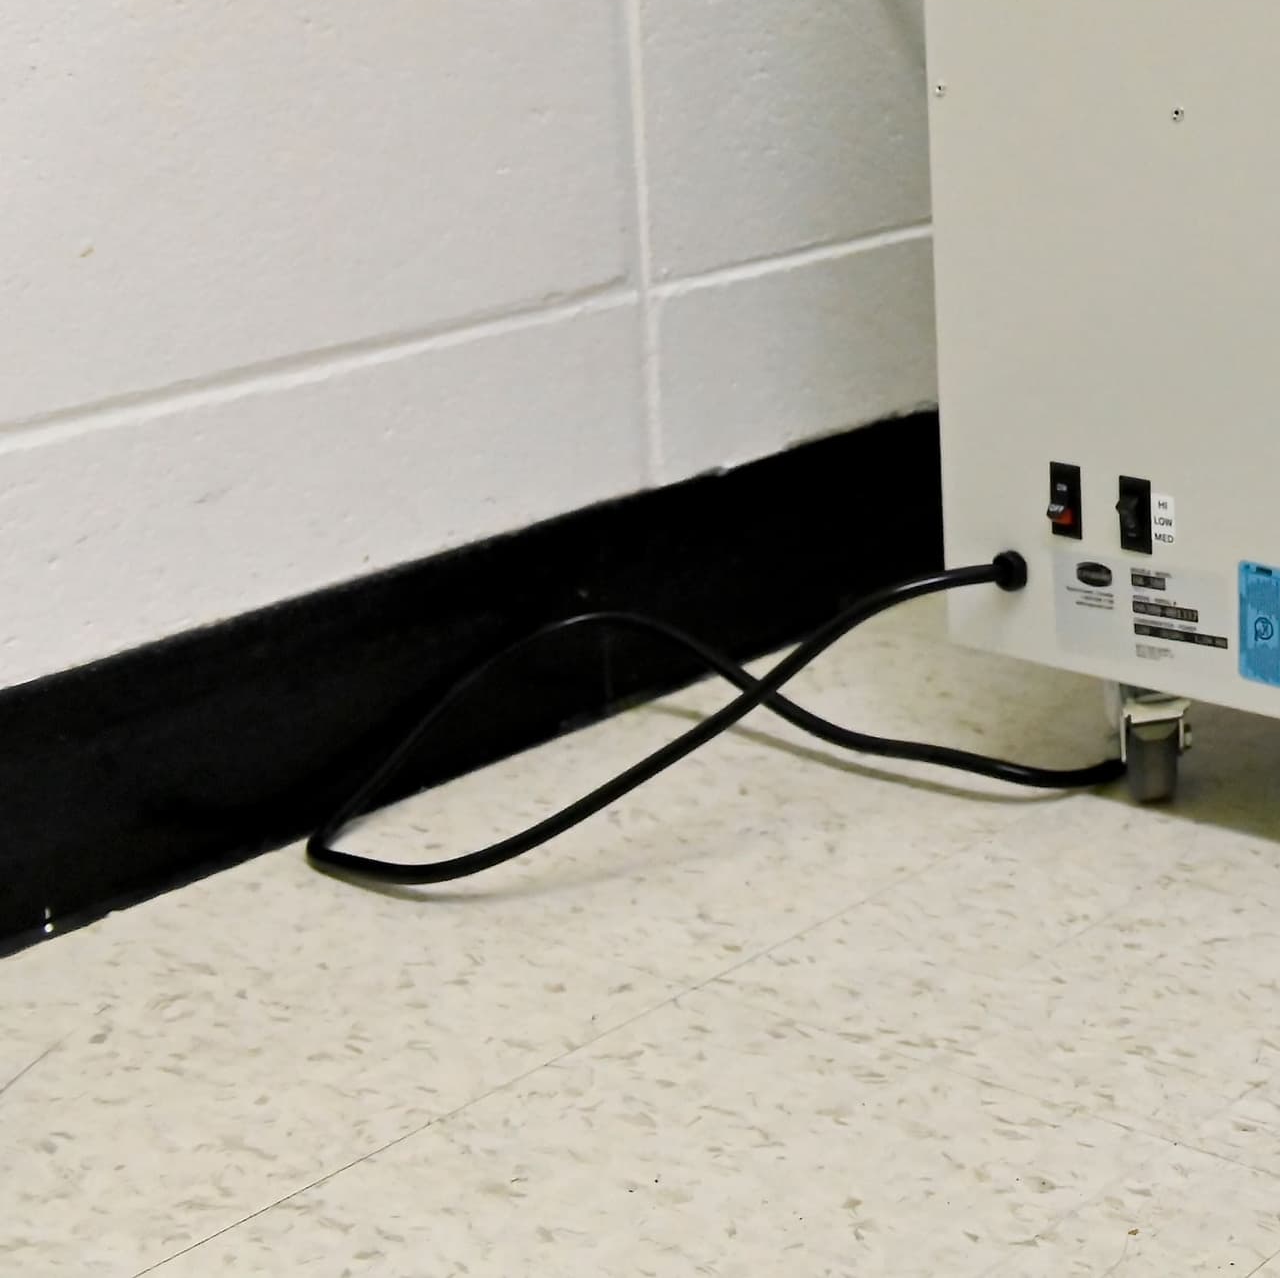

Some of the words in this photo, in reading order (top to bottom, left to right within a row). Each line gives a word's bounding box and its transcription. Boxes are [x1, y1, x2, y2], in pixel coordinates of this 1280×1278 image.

[1048, 503, 1065, 512] OFF
[1158, 500, 1168, 510] HI
[1153, 517, 1173, 527] LOW
[1154, 533, 1174, 543] MED
